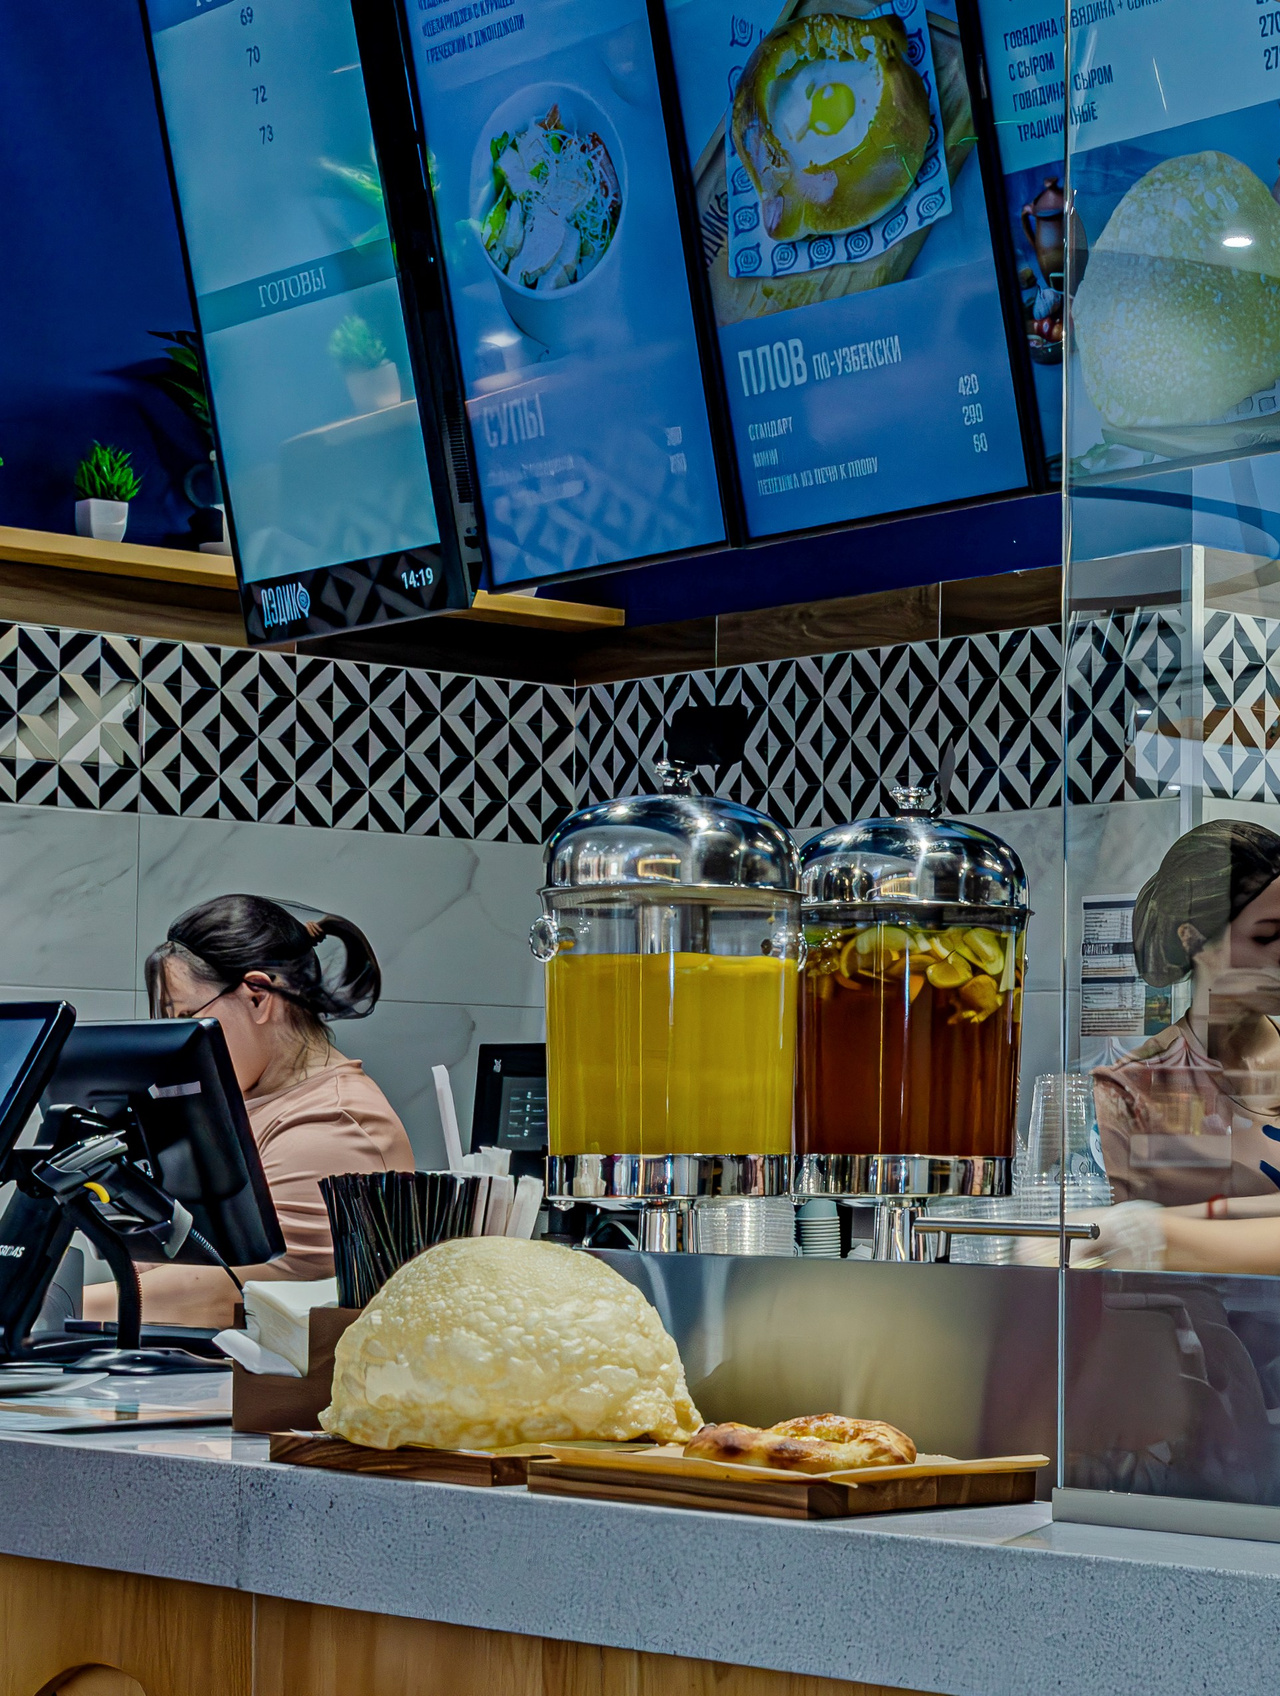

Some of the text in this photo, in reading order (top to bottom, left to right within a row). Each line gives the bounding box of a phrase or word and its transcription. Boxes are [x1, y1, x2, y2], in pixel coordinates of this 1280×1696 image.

[240, 6, 253, 26] 69
[1003, 18, 1058, 51] ГОВЯДИНА
[246, 45, 260, 67] 70
[1008, 52, 1056, 81] С СЫРОМ
[252, 85, 268, 105] 72
[1012, 64, 1114, 112] ГОВЯДИНА СЫРОМ
[259, 124, 274, 145] 73
[258, 266, 327, 308] ГОТОВЫ
[738, 335, 902, 397] ПЛОВ ПО-УЗБЕКСКИ
[958, 373, 980, 396] 420
[483, 393, 545, 448] СУПЫ
[962, 403, 984, 426] 290
[748, 416, 793, 442] СТАНДАРТ
[401, 567, 434, 590] 14:19
